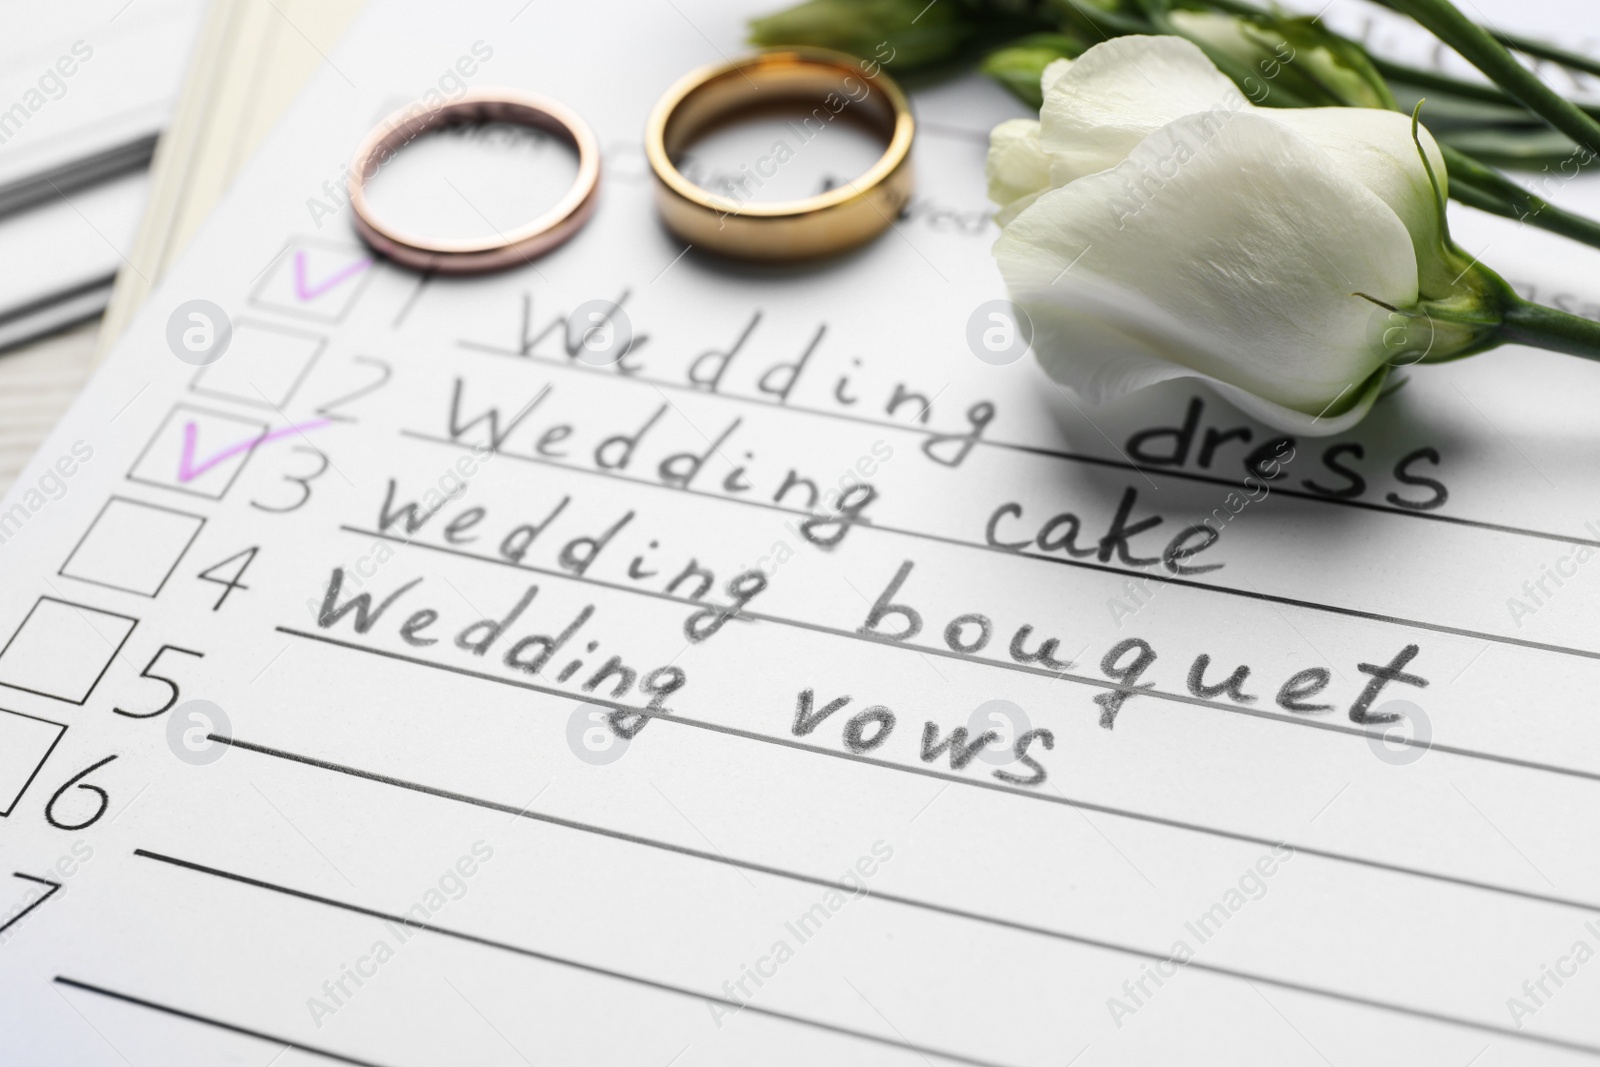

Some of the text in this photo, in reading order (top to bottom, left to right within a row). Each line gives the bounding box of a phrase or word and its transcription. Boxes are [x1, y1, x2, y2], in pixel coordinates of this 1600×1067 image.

[315, 355, 391, 423] 2
[520, 288, 1448, 509] Wedding dress
[251, 446, 328, 513] 3
[449, 377, 1225, 574] Wedding cake
[197, 546, 260, 611] 4
[112, 644, 205, 718] 5
[318, 567, 1055, 785] Wedding vows
[856, 560, 1429, 729] bouquet
[45, 754, 118, 830] 6
[0, 872, 62, 933] 7
